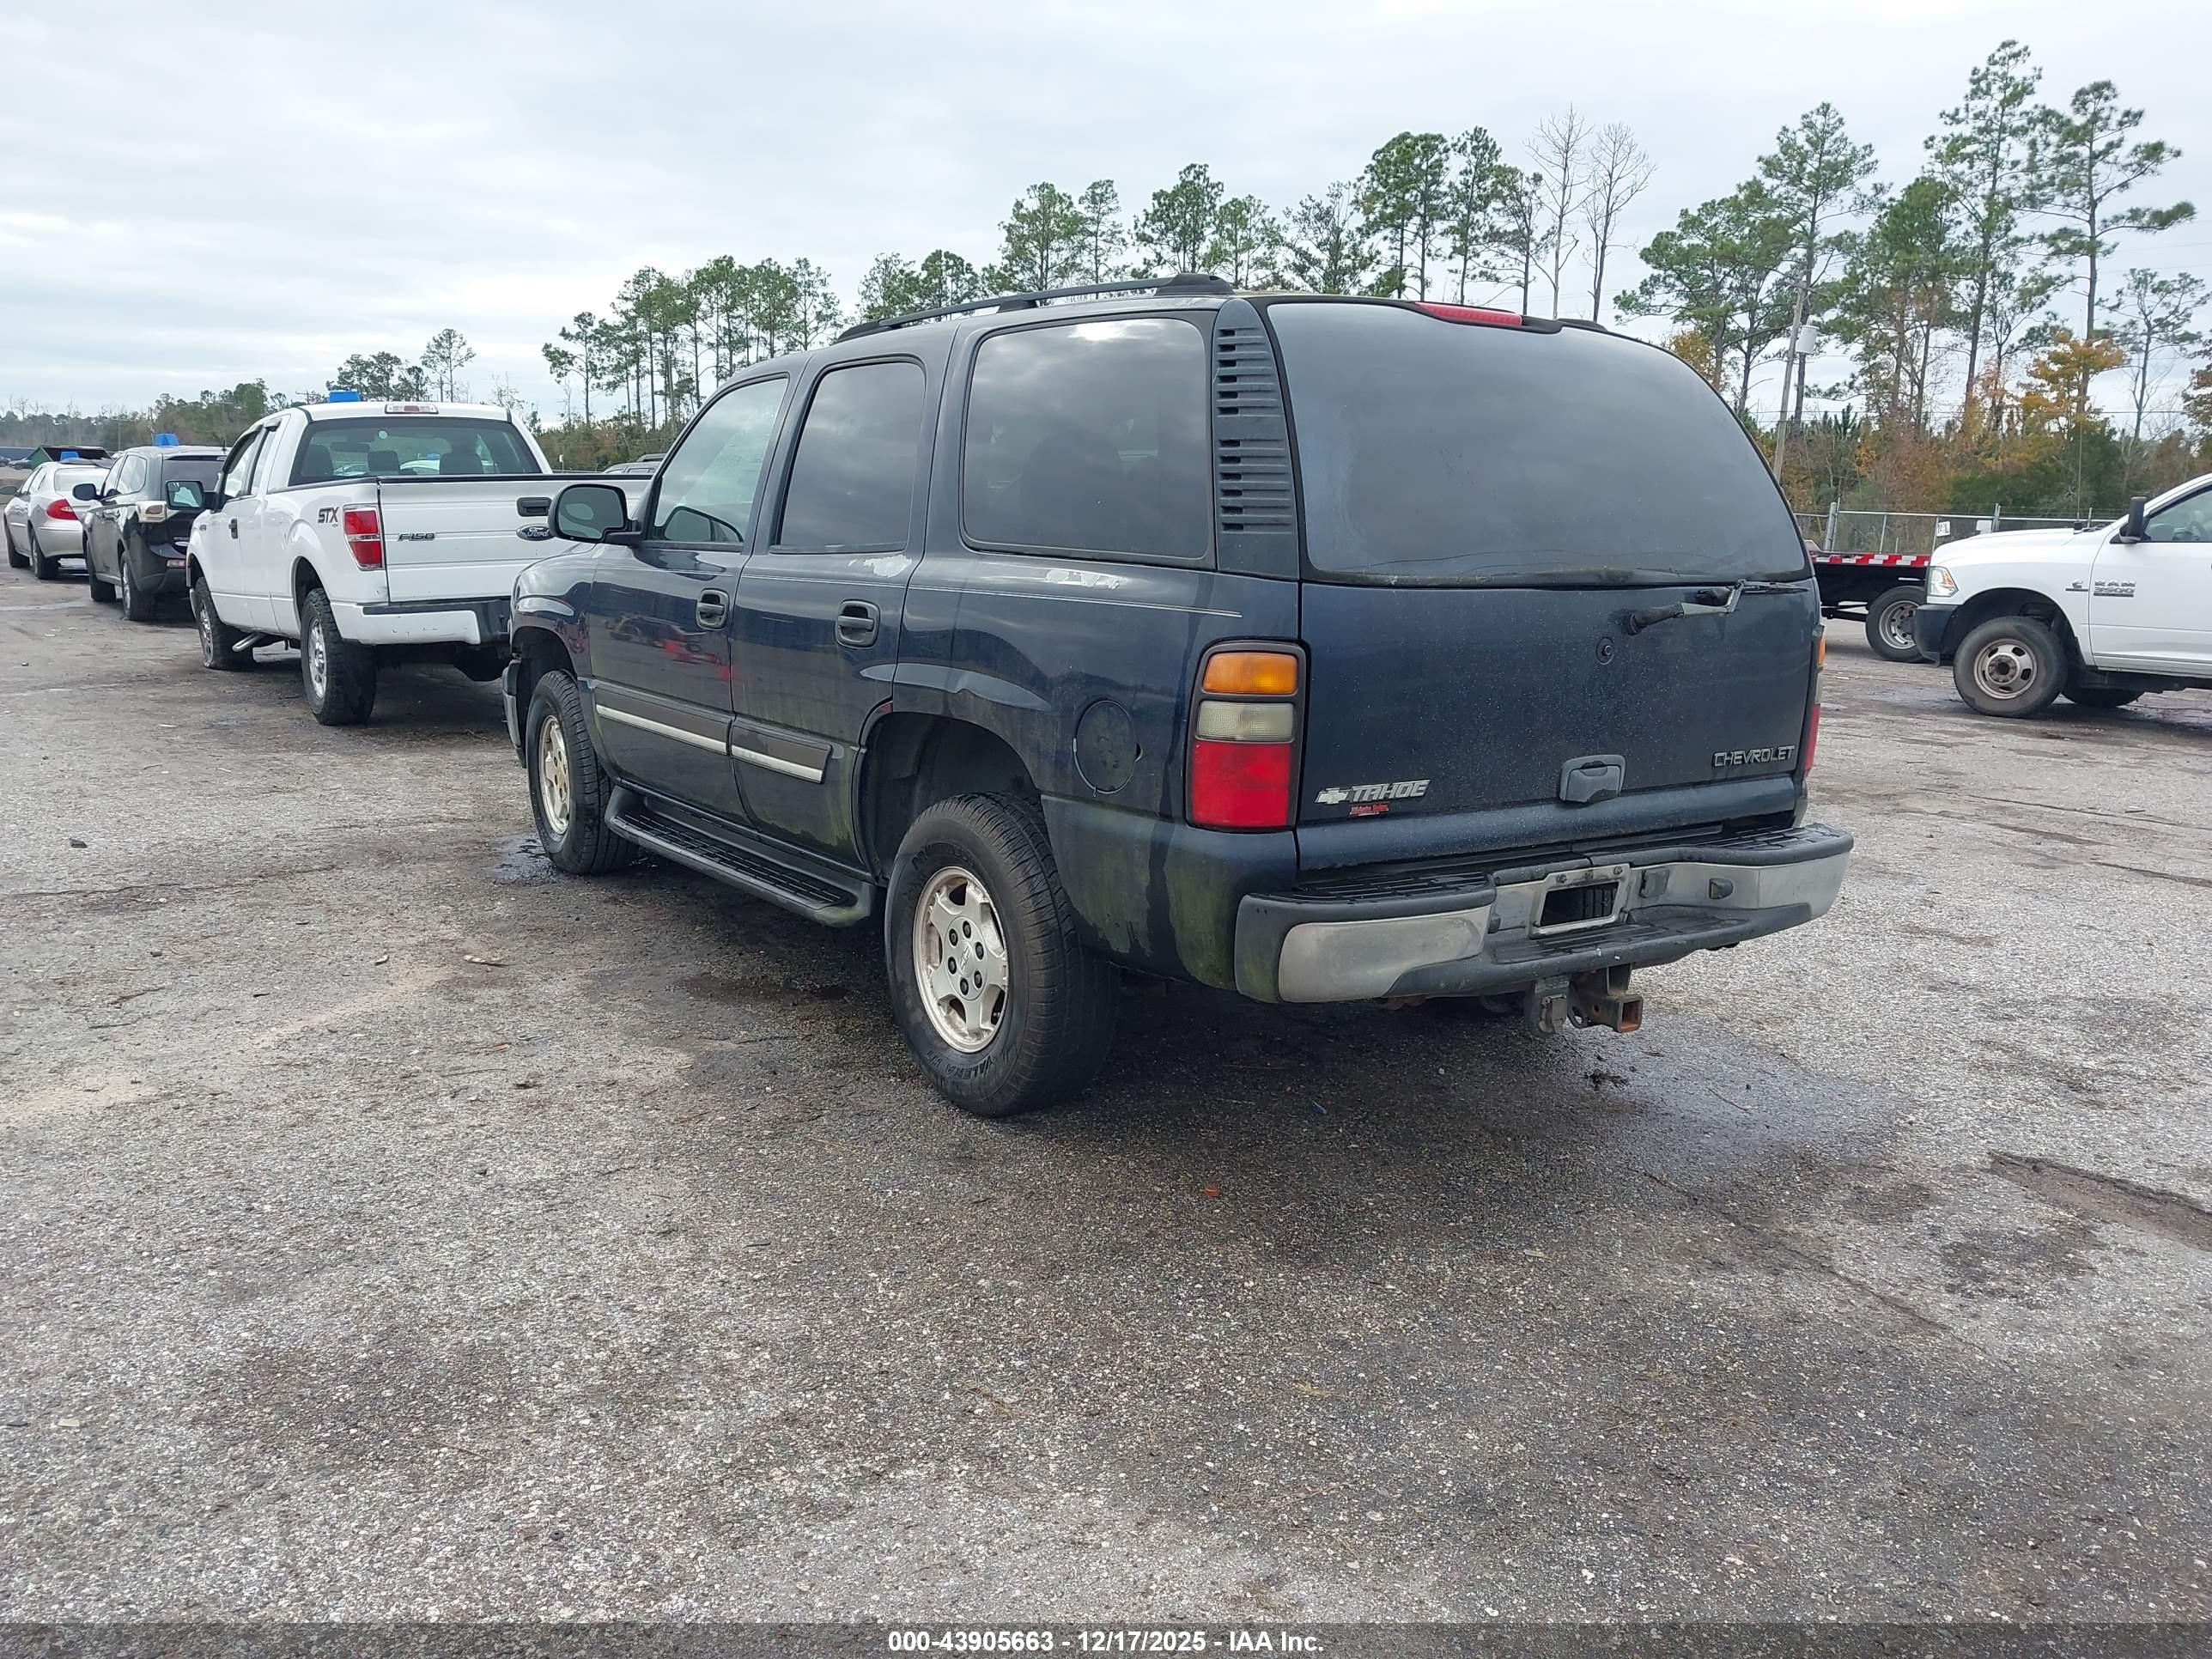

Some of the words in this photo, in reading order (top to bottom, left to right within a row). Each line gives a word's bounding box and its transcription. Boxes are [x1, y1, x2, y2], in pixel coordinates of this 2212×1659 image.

[317, 506, 340, 524] STX
[521, 526, 550, 538] Ford
[1713, 744, 1796, 768] CHEVROLET
[1351, 779, 1431, 803] TAHOE
